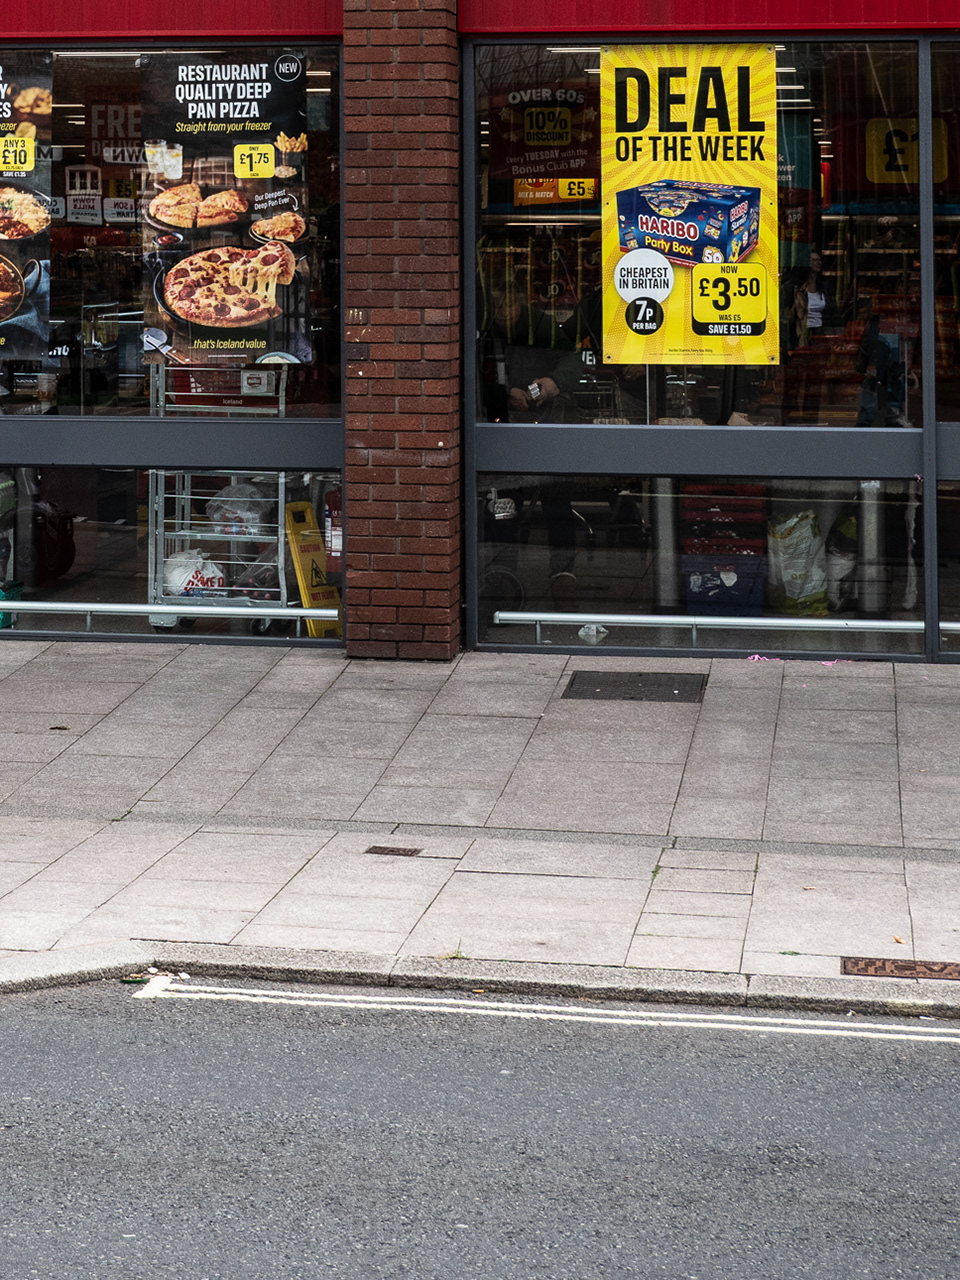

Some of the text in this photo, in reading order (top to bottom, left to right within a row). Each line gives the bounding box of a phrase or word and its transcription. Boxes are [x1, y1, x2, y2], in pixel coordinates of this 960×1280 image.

[178, 64, 269, 82] RESTAURANT
[278, 63, 298, 73] NEW
[175, 82, 272, 103] QUALITY DEEP
[508, 88, 552, 105] OVER
[614, 66, 765, 133] DEAL
[188, 101, 260, 119] PAN PIZZA
[175, 121, 272, 135] Straight from your freezer
[526, 111, 568, 130] 10%
[3, 139, 26, 148] ANY 3
[526, 131, 569, 142] DISCOUNT
[524, 149, 560, 161] TUESDAY
[615, 135, 765, 162] OF THE WEEK
[1, 149, 27, 165] £10
[240, 153, 269, 172] £1.75
[511, 158, 586, 175] Bonus Club APP
[254, 189, 286, 202] Our Deepest
[567, 181, 585, 196] £5
[254, 197, 290, 211] Deep Pan Ever
[638, 214, 700, 241] HARIBO
[644, 236, 693, 256] Party Box
[704, 249, 723, 263] 50
[619, 267, 668, 278] CHEAPEST
[720, 266, 738, 274] NOW
[619, 278, 670, 289] IN BRITAIN
[699, 277, 760, 311] £3.50
[635, 300, 653, 321] 7P
[708, 324, 752, 334] SAVE £1.50
